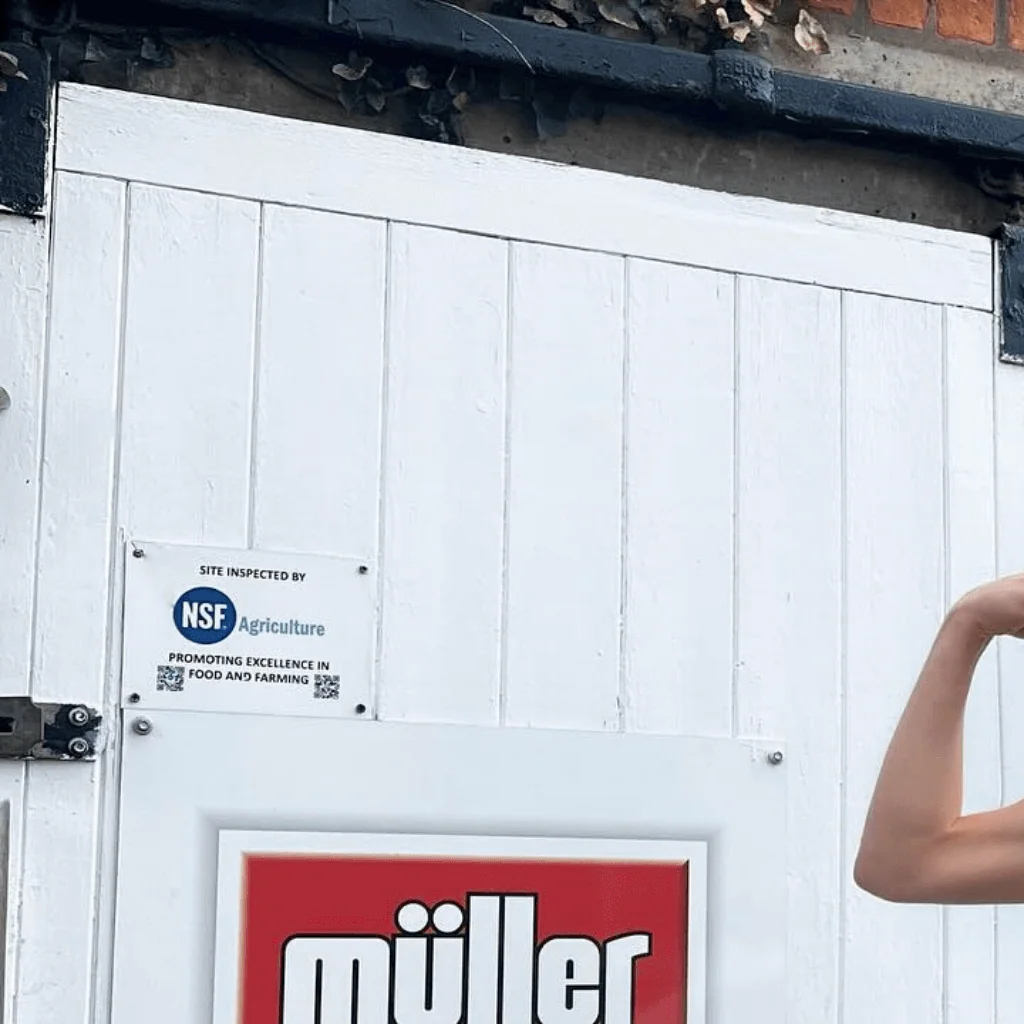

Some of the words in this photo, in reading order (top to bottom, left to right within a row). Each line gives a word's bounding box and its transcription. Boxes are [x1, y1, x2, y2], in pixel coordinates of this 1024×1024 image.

[200, 565, 224, 577] SITE
[226, 567, 289, 581] INSPECTED
[291, 572, 306, 583] BY
[182, 601, 228, 630] NSF
[238, 616, 326, 636] Agriculture
[168, 652, 243, 667] PROMOTING
[246, 657, 314, 671] EXCELLENCE
[317, 661, 330, 671] IN
[188, 669, 223, 681] FOOD
[225, 671, 251, 682] AND
[254, 673, 310, 685] FARMING
